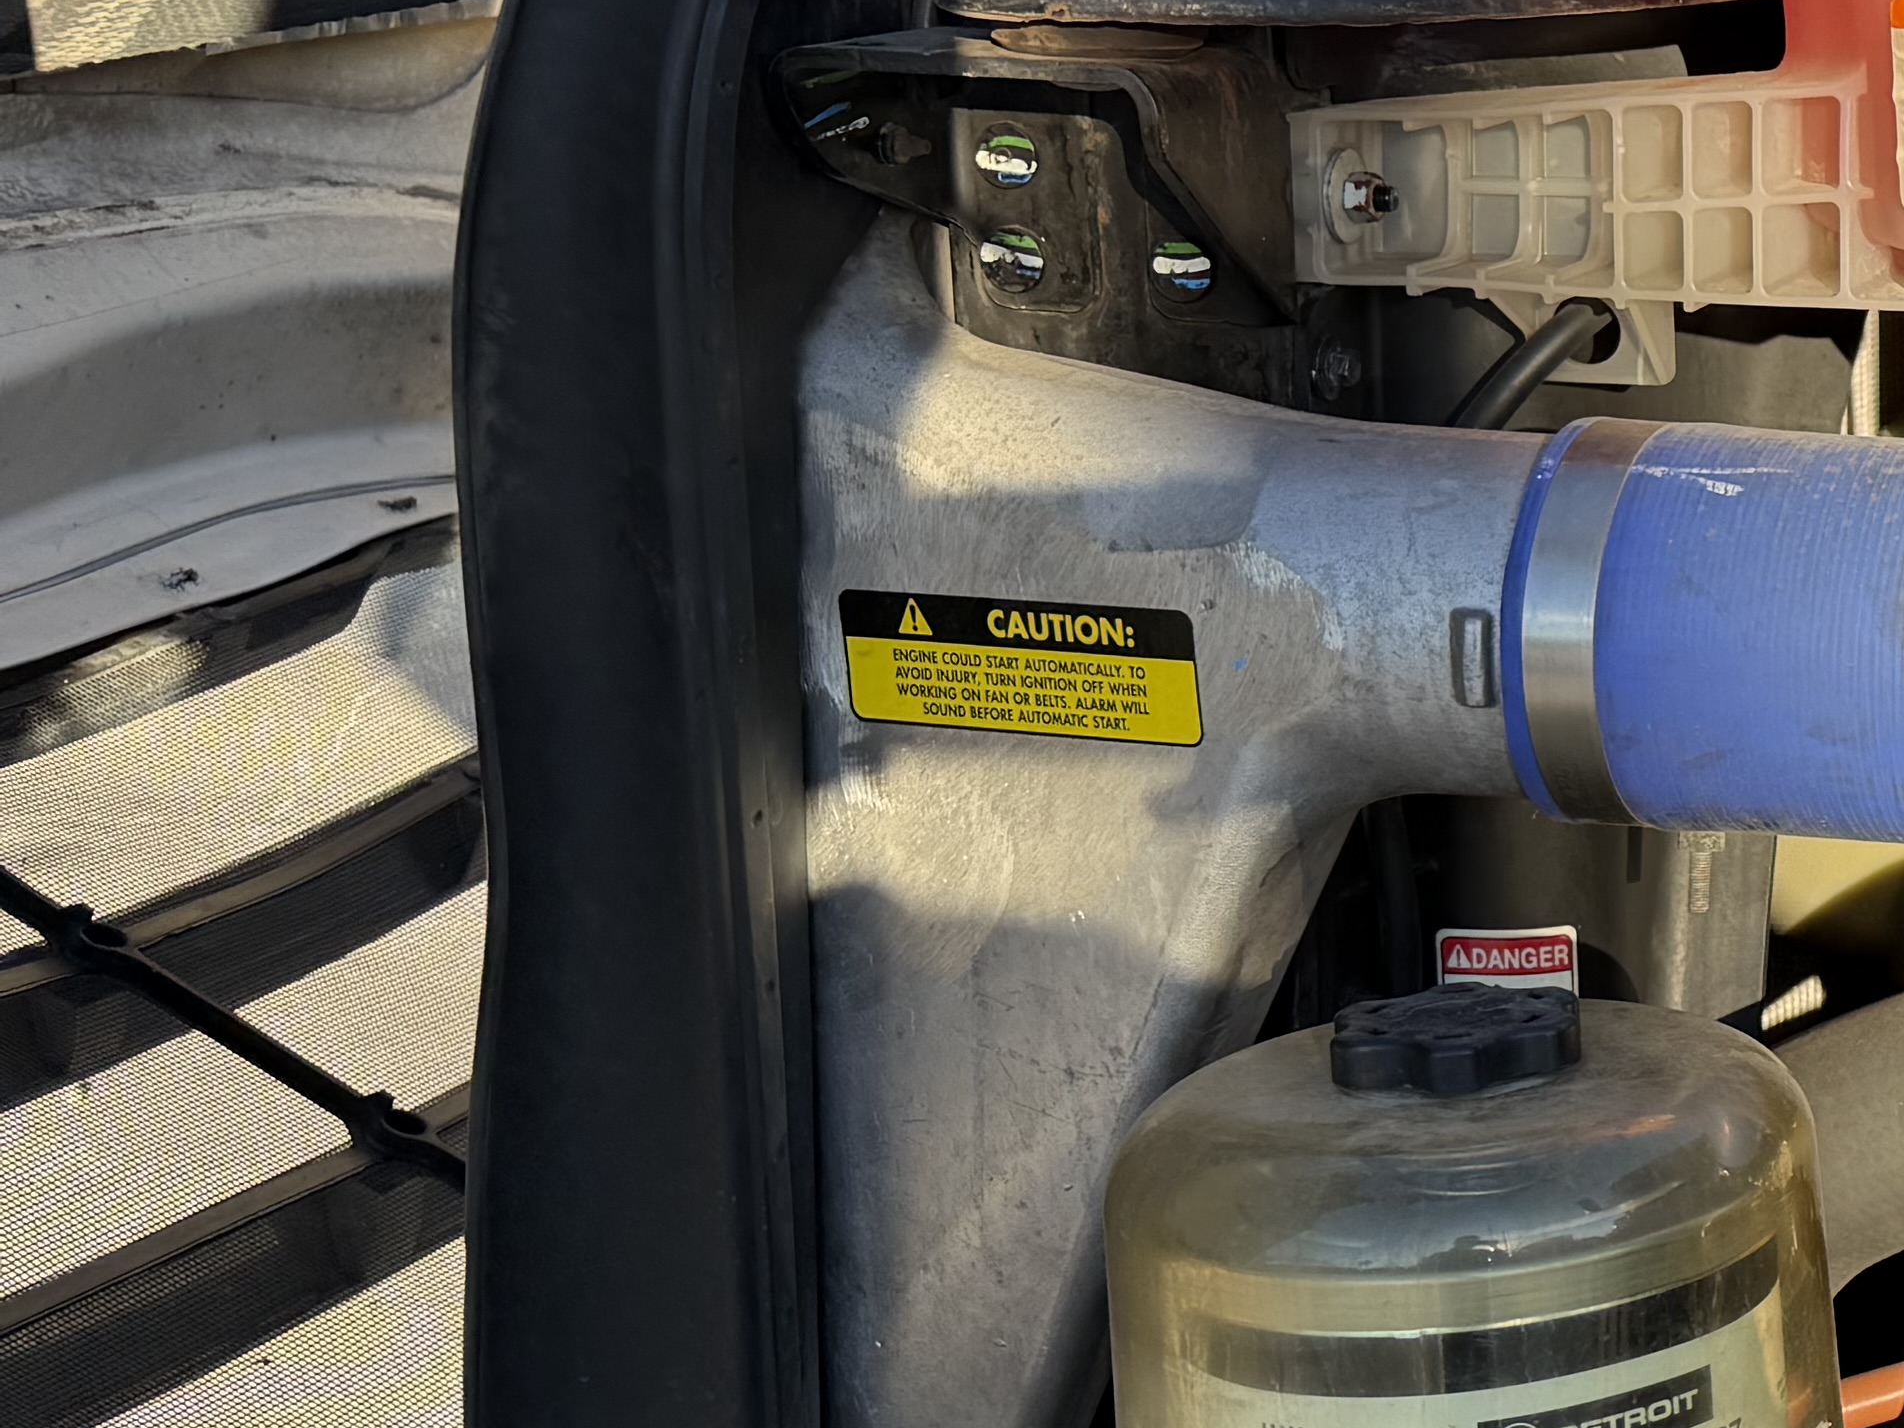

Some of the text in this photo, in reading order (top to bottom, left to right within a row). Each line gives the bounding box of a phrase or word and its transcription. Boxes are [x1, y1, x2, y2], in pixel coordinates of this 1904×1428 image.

[986, 608, 1135, 649] CAUTION:
[893, 648, 1146, 680] ENGINE COULD START AUTOMATICALLY. TO
[895, 666, 1148, 698] AVOID INJURY, TURN IGNITION OFF WHEN
[896, 683, 1150, 715] WORKING ON FAN OR BELTS. ALARM WILL
[923, 702, 1131, 731] SOUND BEFORE AUTOMATIC START.
[1471, 944, 1569, 970] DANGER
